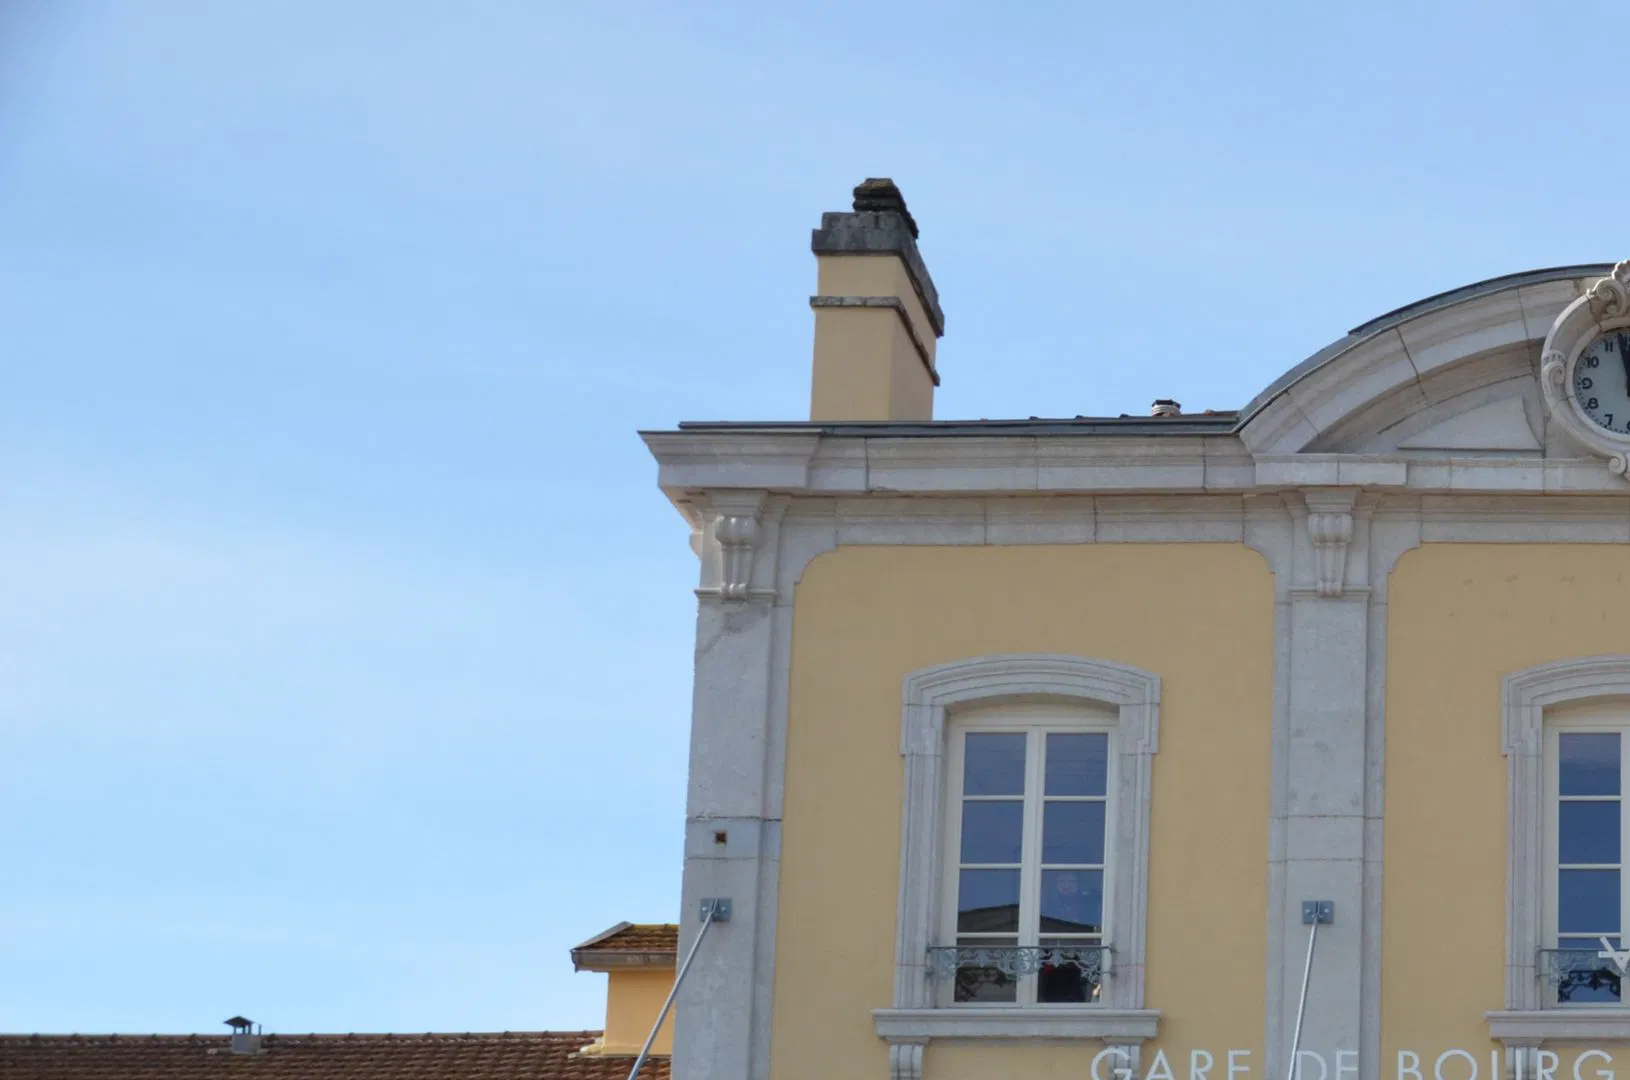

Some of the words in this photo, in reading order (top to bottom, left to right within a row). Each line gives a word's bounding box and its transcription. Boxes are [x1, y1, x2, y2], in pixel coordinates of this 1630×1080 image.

[1604, 341, 1613, 352] 11
[1586, 356, 1599, 368] 10
[1581, 377, 1593, 389] 9
[1587, 398, 1599, 409] 8
[1604, 414, 1613, 426] 7
